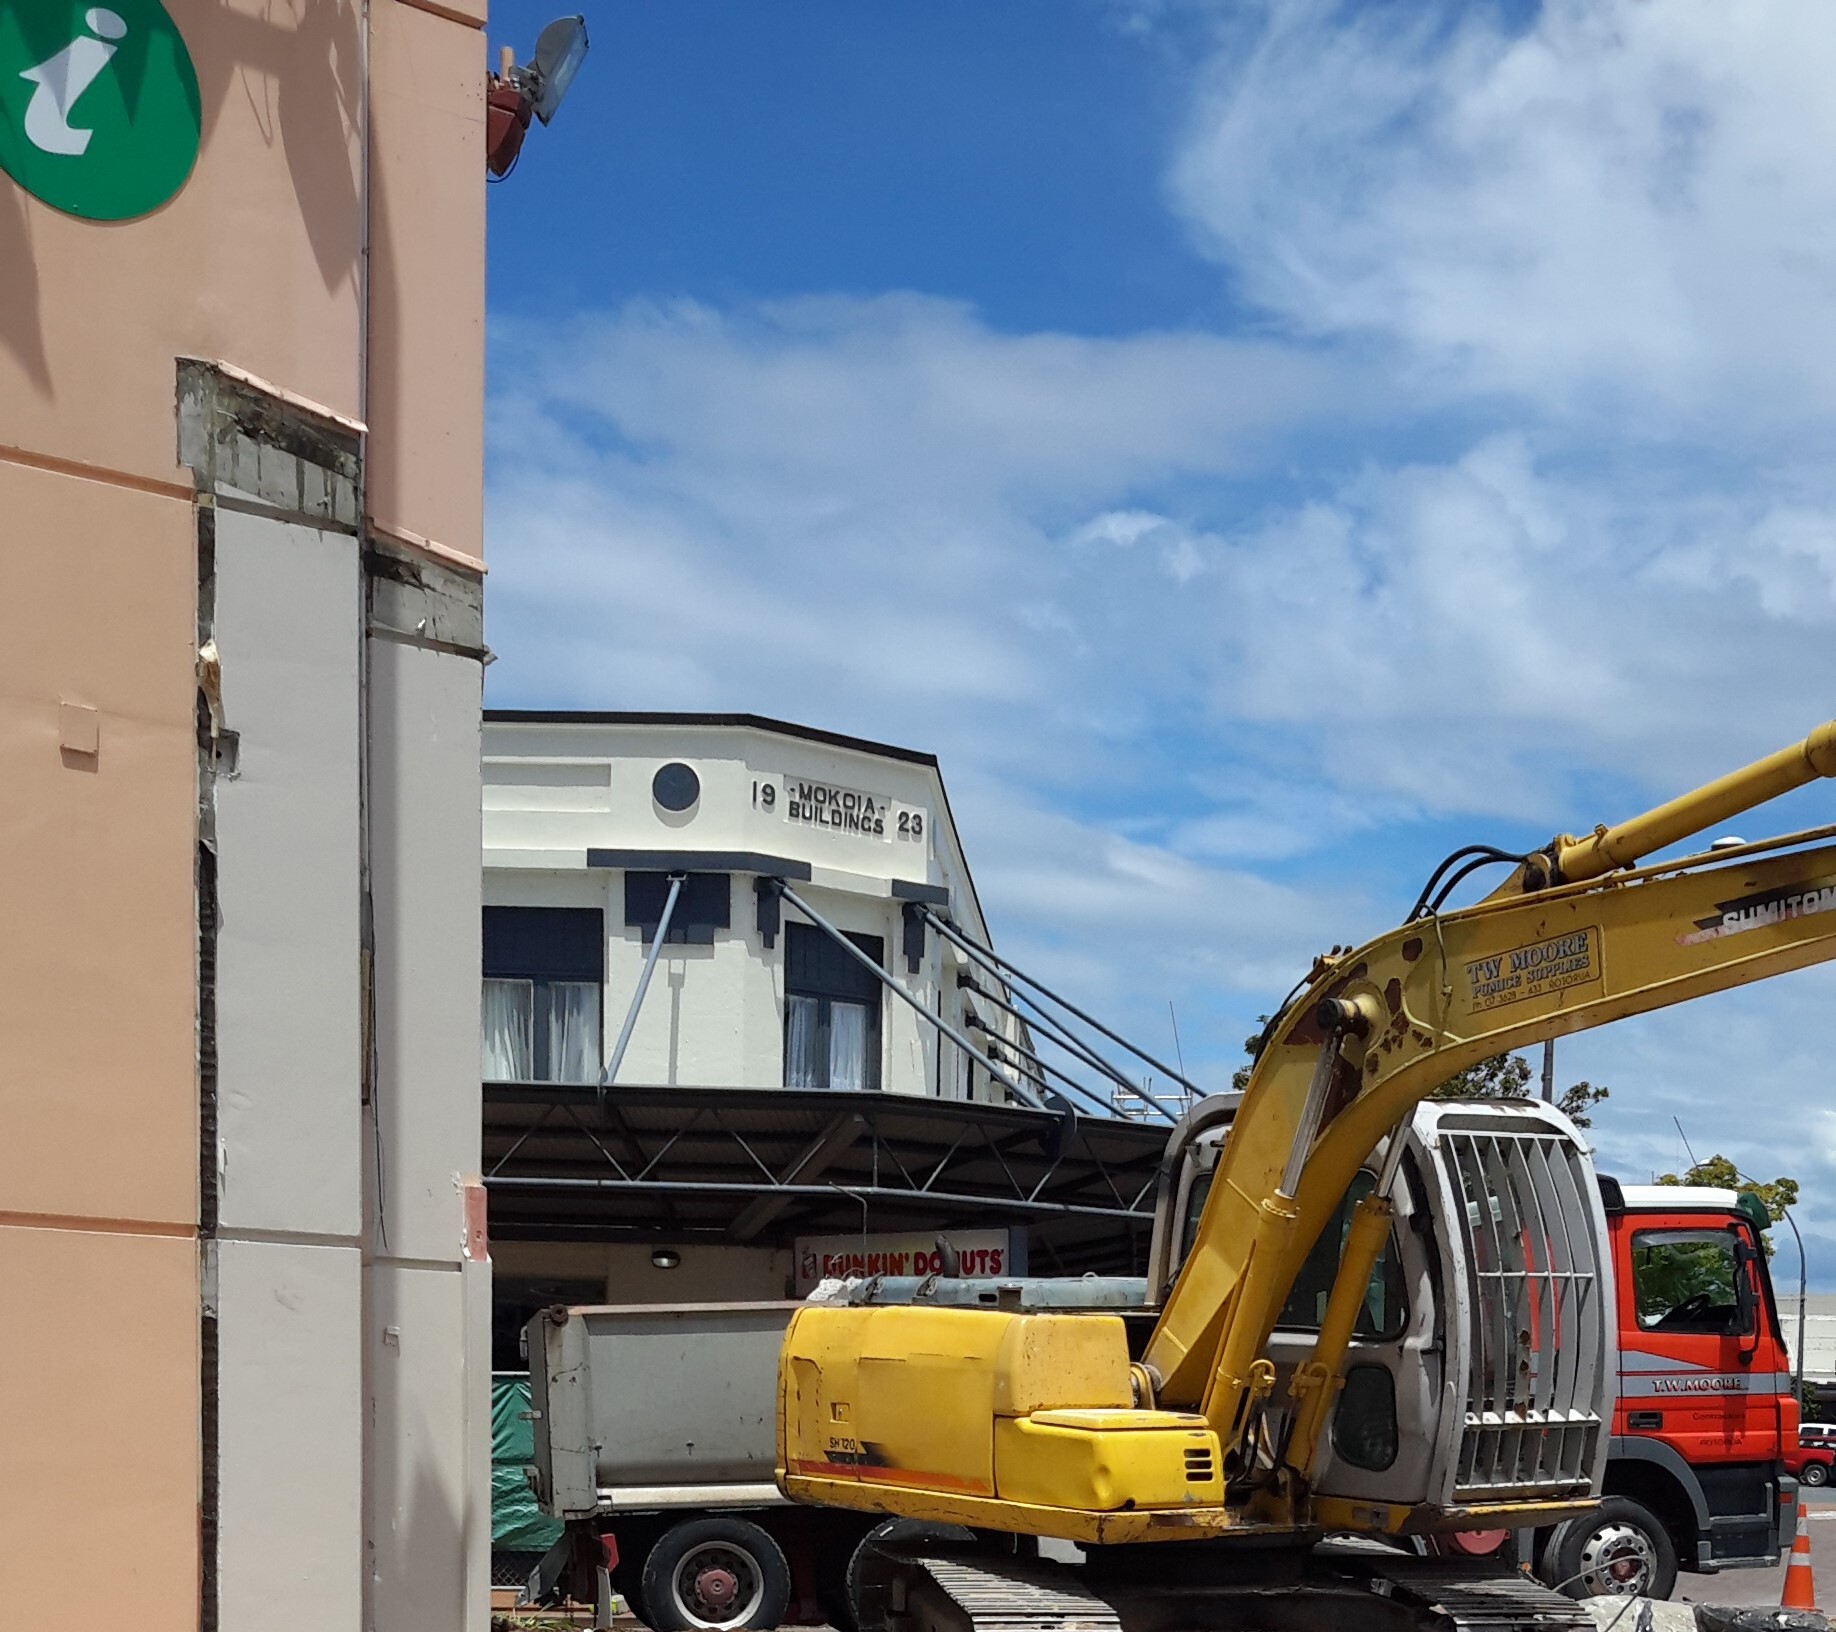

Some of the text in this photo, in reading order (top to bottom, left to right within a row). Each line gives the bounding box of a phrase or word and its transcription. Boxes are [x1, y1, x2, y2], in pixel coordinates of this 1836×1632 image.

[752, 780, 776, 806] 19
[798, 782, 876, 815] MOKOIA
[788, 801, 884, 835] BUILDINGS
[897, 811, 923, 836] 23
[1467, 931, 1589, 984] TW MOORE
[1472, 954, 1591, 999] PUMICE SUPPLIES
[1548, 970, 1591, 989] ROTORUA
[914, 1249, 1003, 1276] DOUTS
[829, 1436, 855, 1450] SH 120
